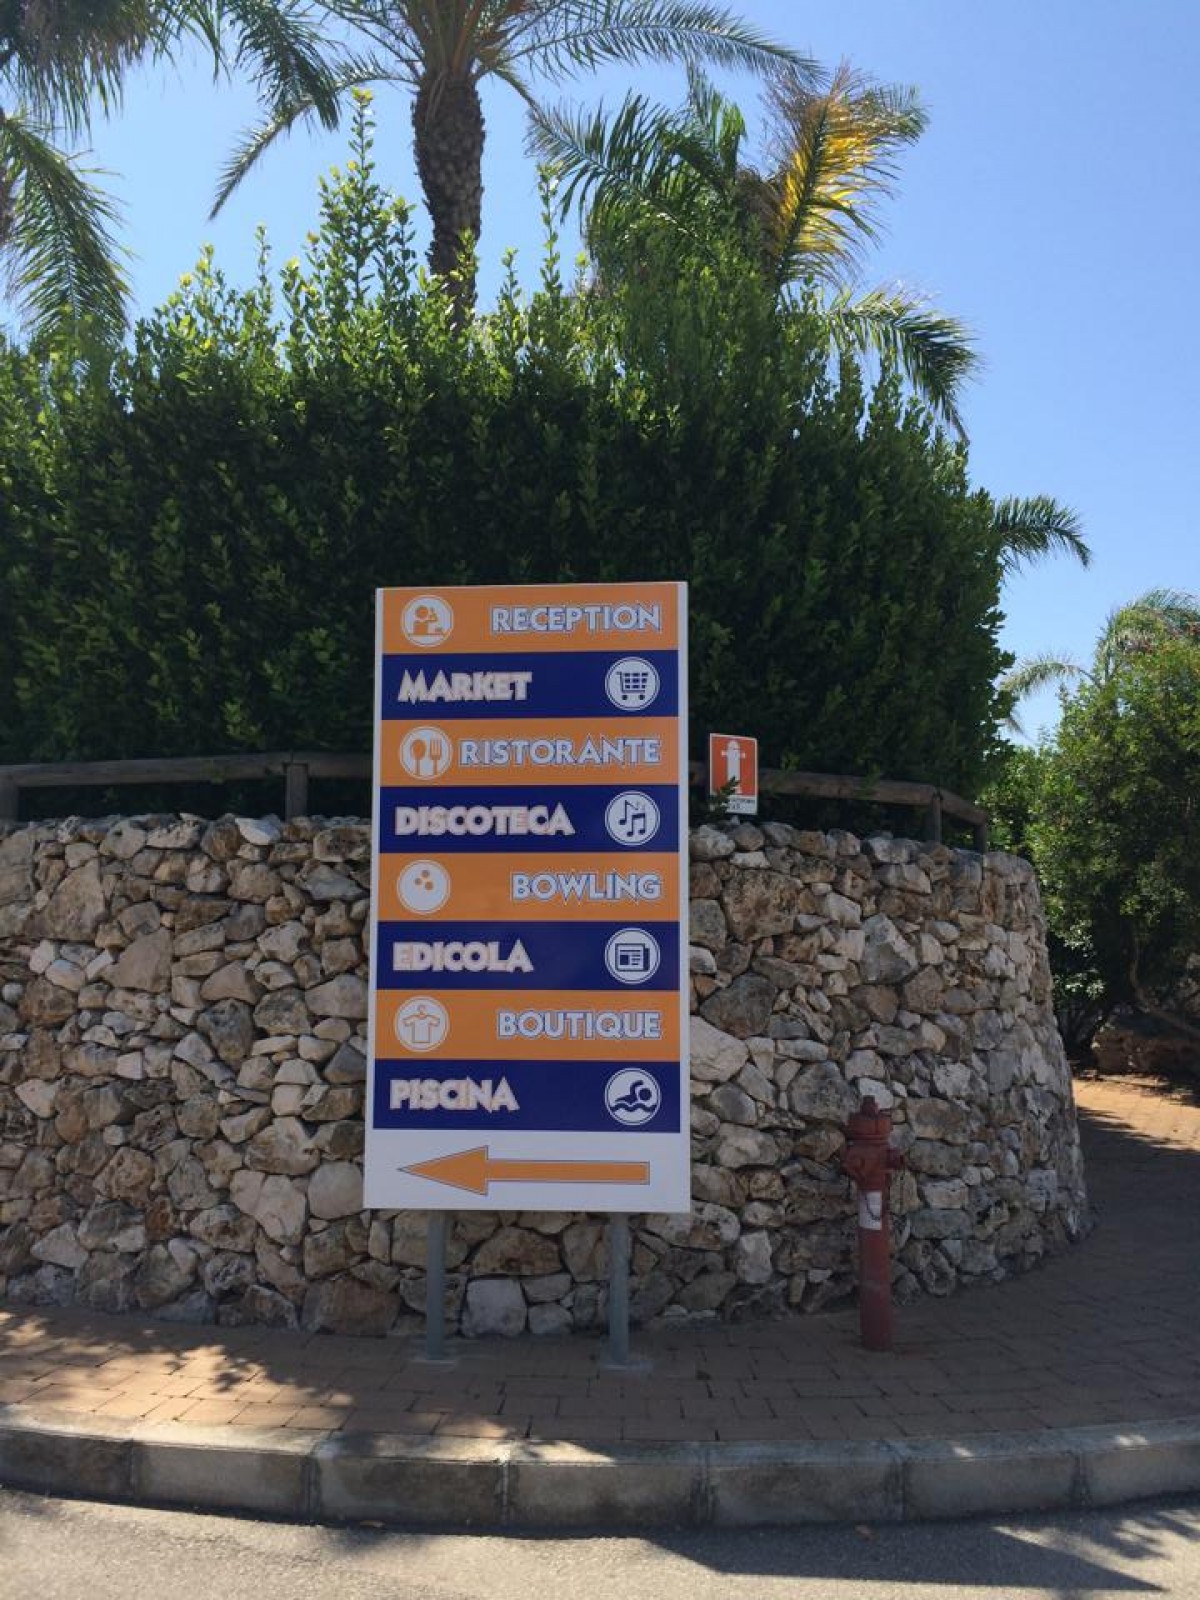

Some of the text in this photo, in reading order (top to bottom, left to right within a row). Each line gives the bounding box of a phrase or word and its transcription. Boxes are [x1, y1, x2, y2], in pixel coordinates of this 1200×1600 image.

[491, 602, 662, 634] RECEPTION
[398, 670, 533, 704] MARKET
[459, 734, 662, 767] RISTORANTE
[394, 802, 576, 836] DISCOTECA
[511, 871, 662, 905] BOWLING
[392, 939, 534, 972] EDICOLA
[497, 1009, 662, 1041] BOUTIQUE
[389, 1076, 520, 1112] PISCINA
